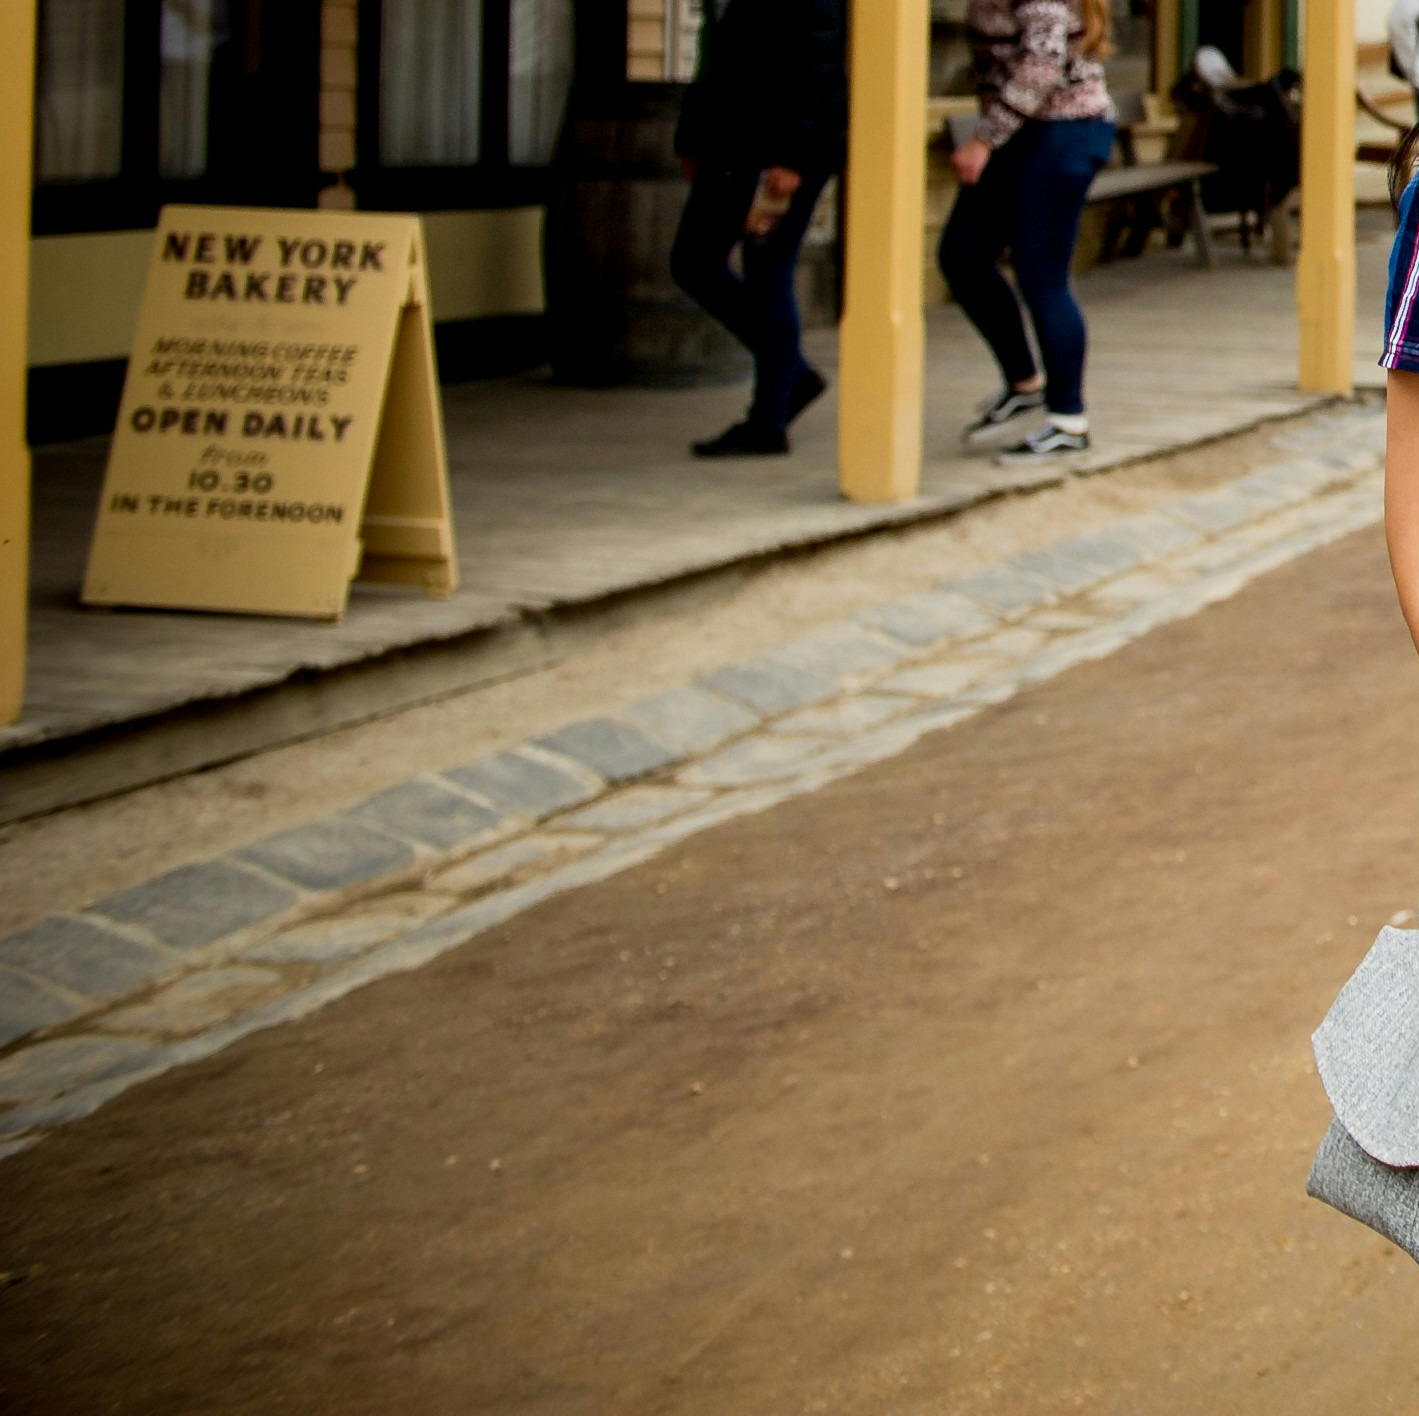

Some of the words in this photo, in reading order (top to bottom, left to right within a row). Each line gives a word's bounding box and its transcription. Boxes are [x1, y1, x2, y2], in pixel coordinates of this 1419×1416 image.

[161, 230, 264, 267] NEW
[276, 237, 388, 272] YORK
[184, 270, 360, 306] BAKERY
[151, 336, 269, 363] MORNING
[271, 342, 360, 364] COFFEE
[144, 359, 282, 382] AFTERNOON
[129, 406, 228, 437] OPEN
[241, 412, 353, 443] DAILY
[110, 494, 139, 514] IN
[147, 495, 198, 520] THE
[204, 496, 344, 526] FORENOON
